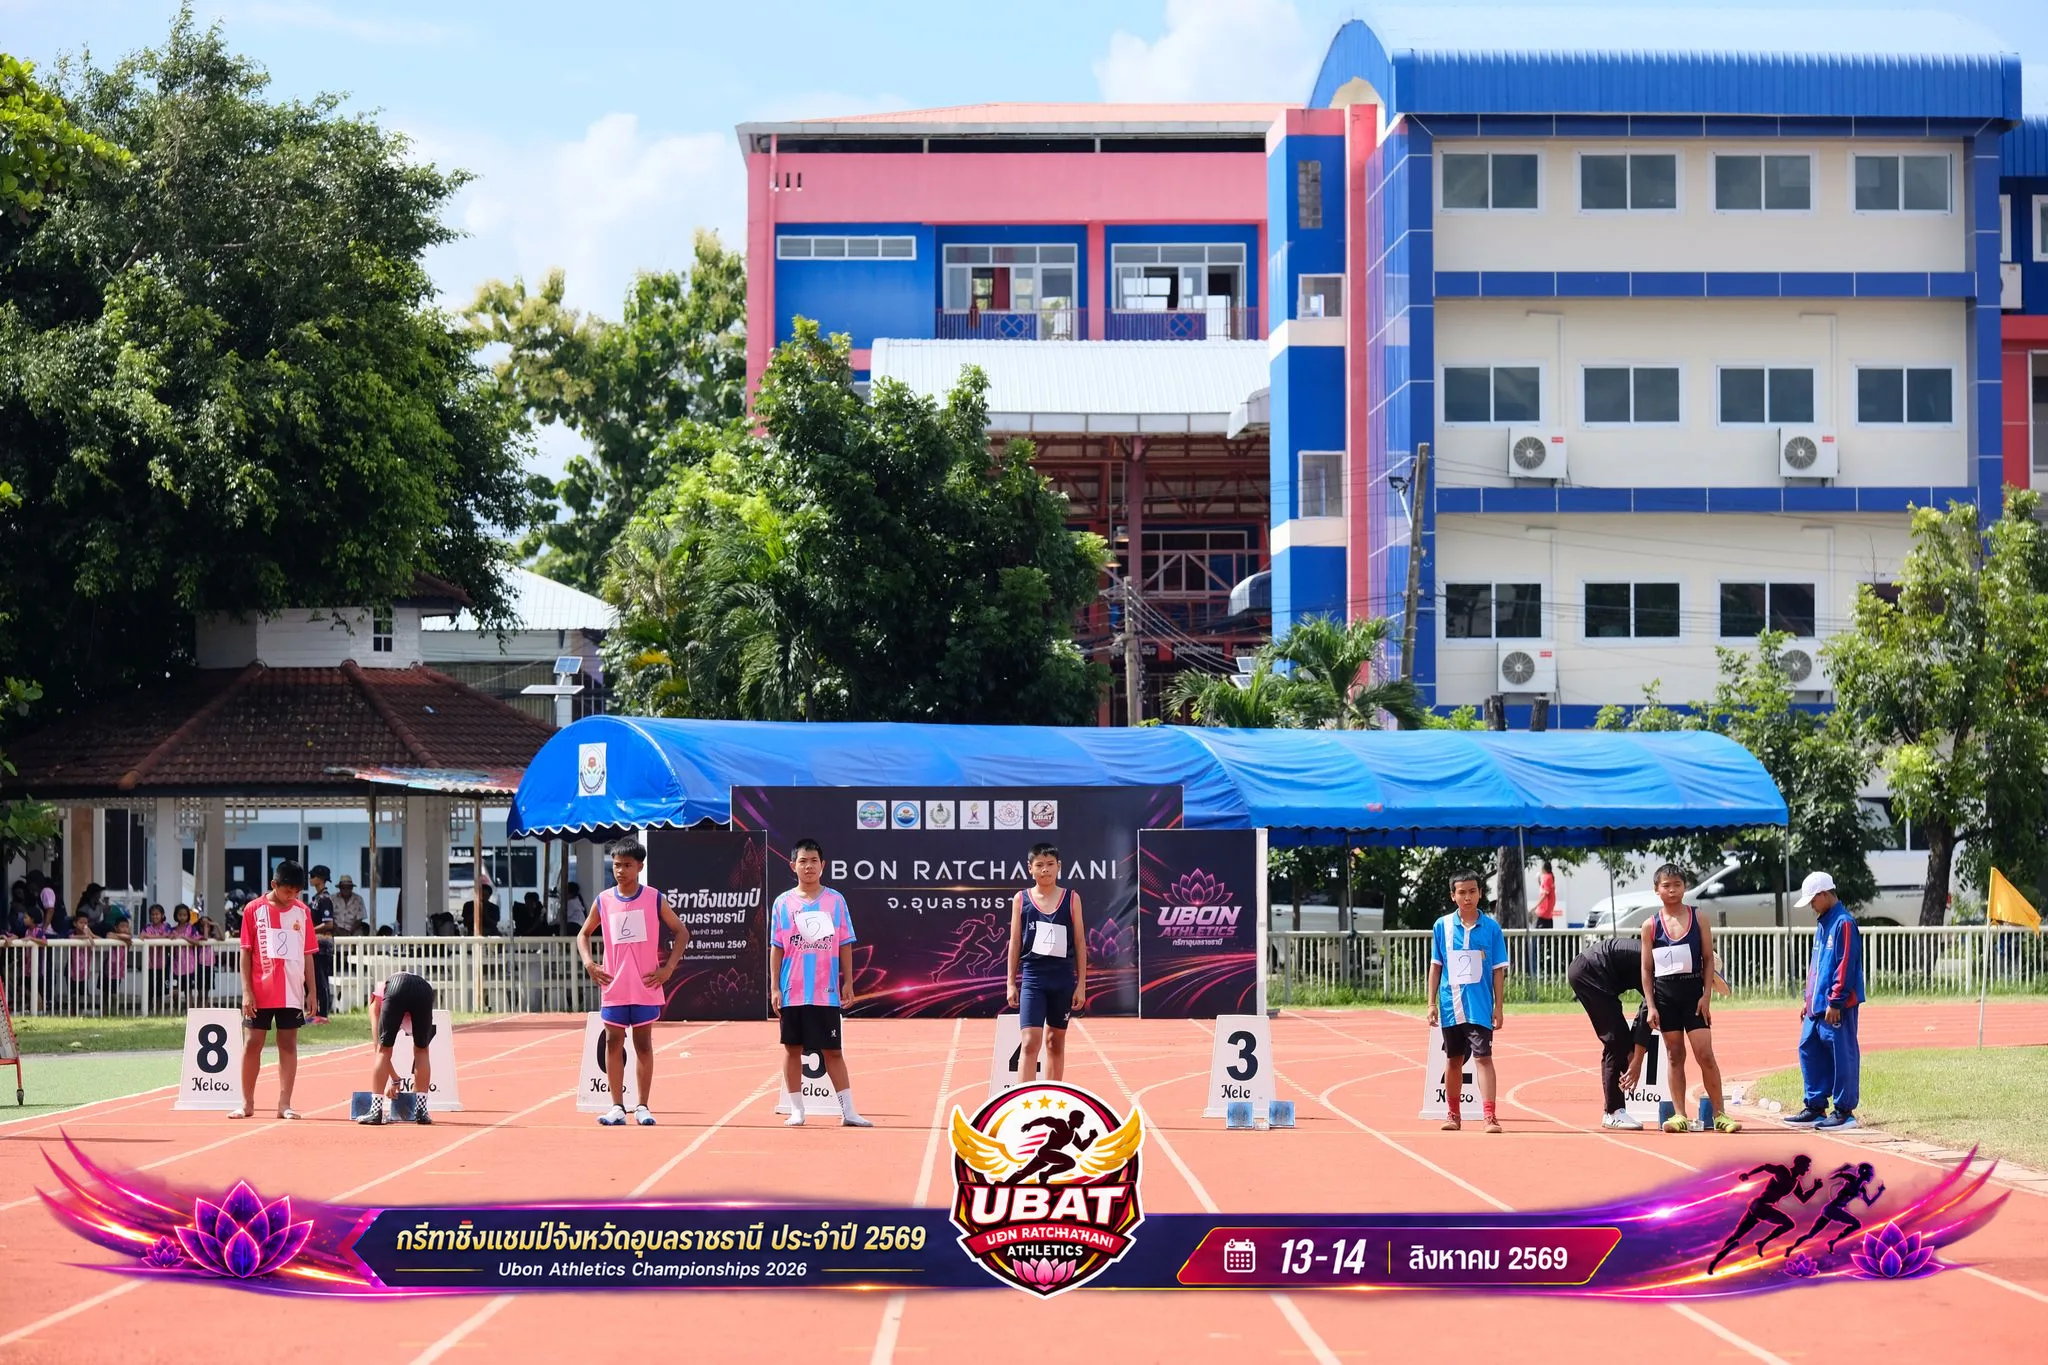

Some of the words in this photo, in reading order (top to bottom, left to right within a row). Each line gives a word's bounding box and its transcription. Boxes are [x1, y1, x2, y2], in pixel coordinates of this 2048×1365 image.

[831, 860, 897, 880] BON
[913, 860, 1117, 880] RATCHAANI
[1157, 906, 1242, 926] UBON
[619, 916, 633, 938] 6
[805, 916, 821, 937] 5
[1159, 926, 1238, 937] ATHLETICS
[276, 931, 288, 957] 8
[727, 940, 747, 949] 2569
[1043, 928, 1056, 948] 4
[1457, 955, 1473, 978] 2
[197, 1023, 229, 1074] 8
[1226, 1030, 1258, 1081] 3
[191, 1077, 230, 1092] Nelco
[801, 1082, 829, 1097] elco
